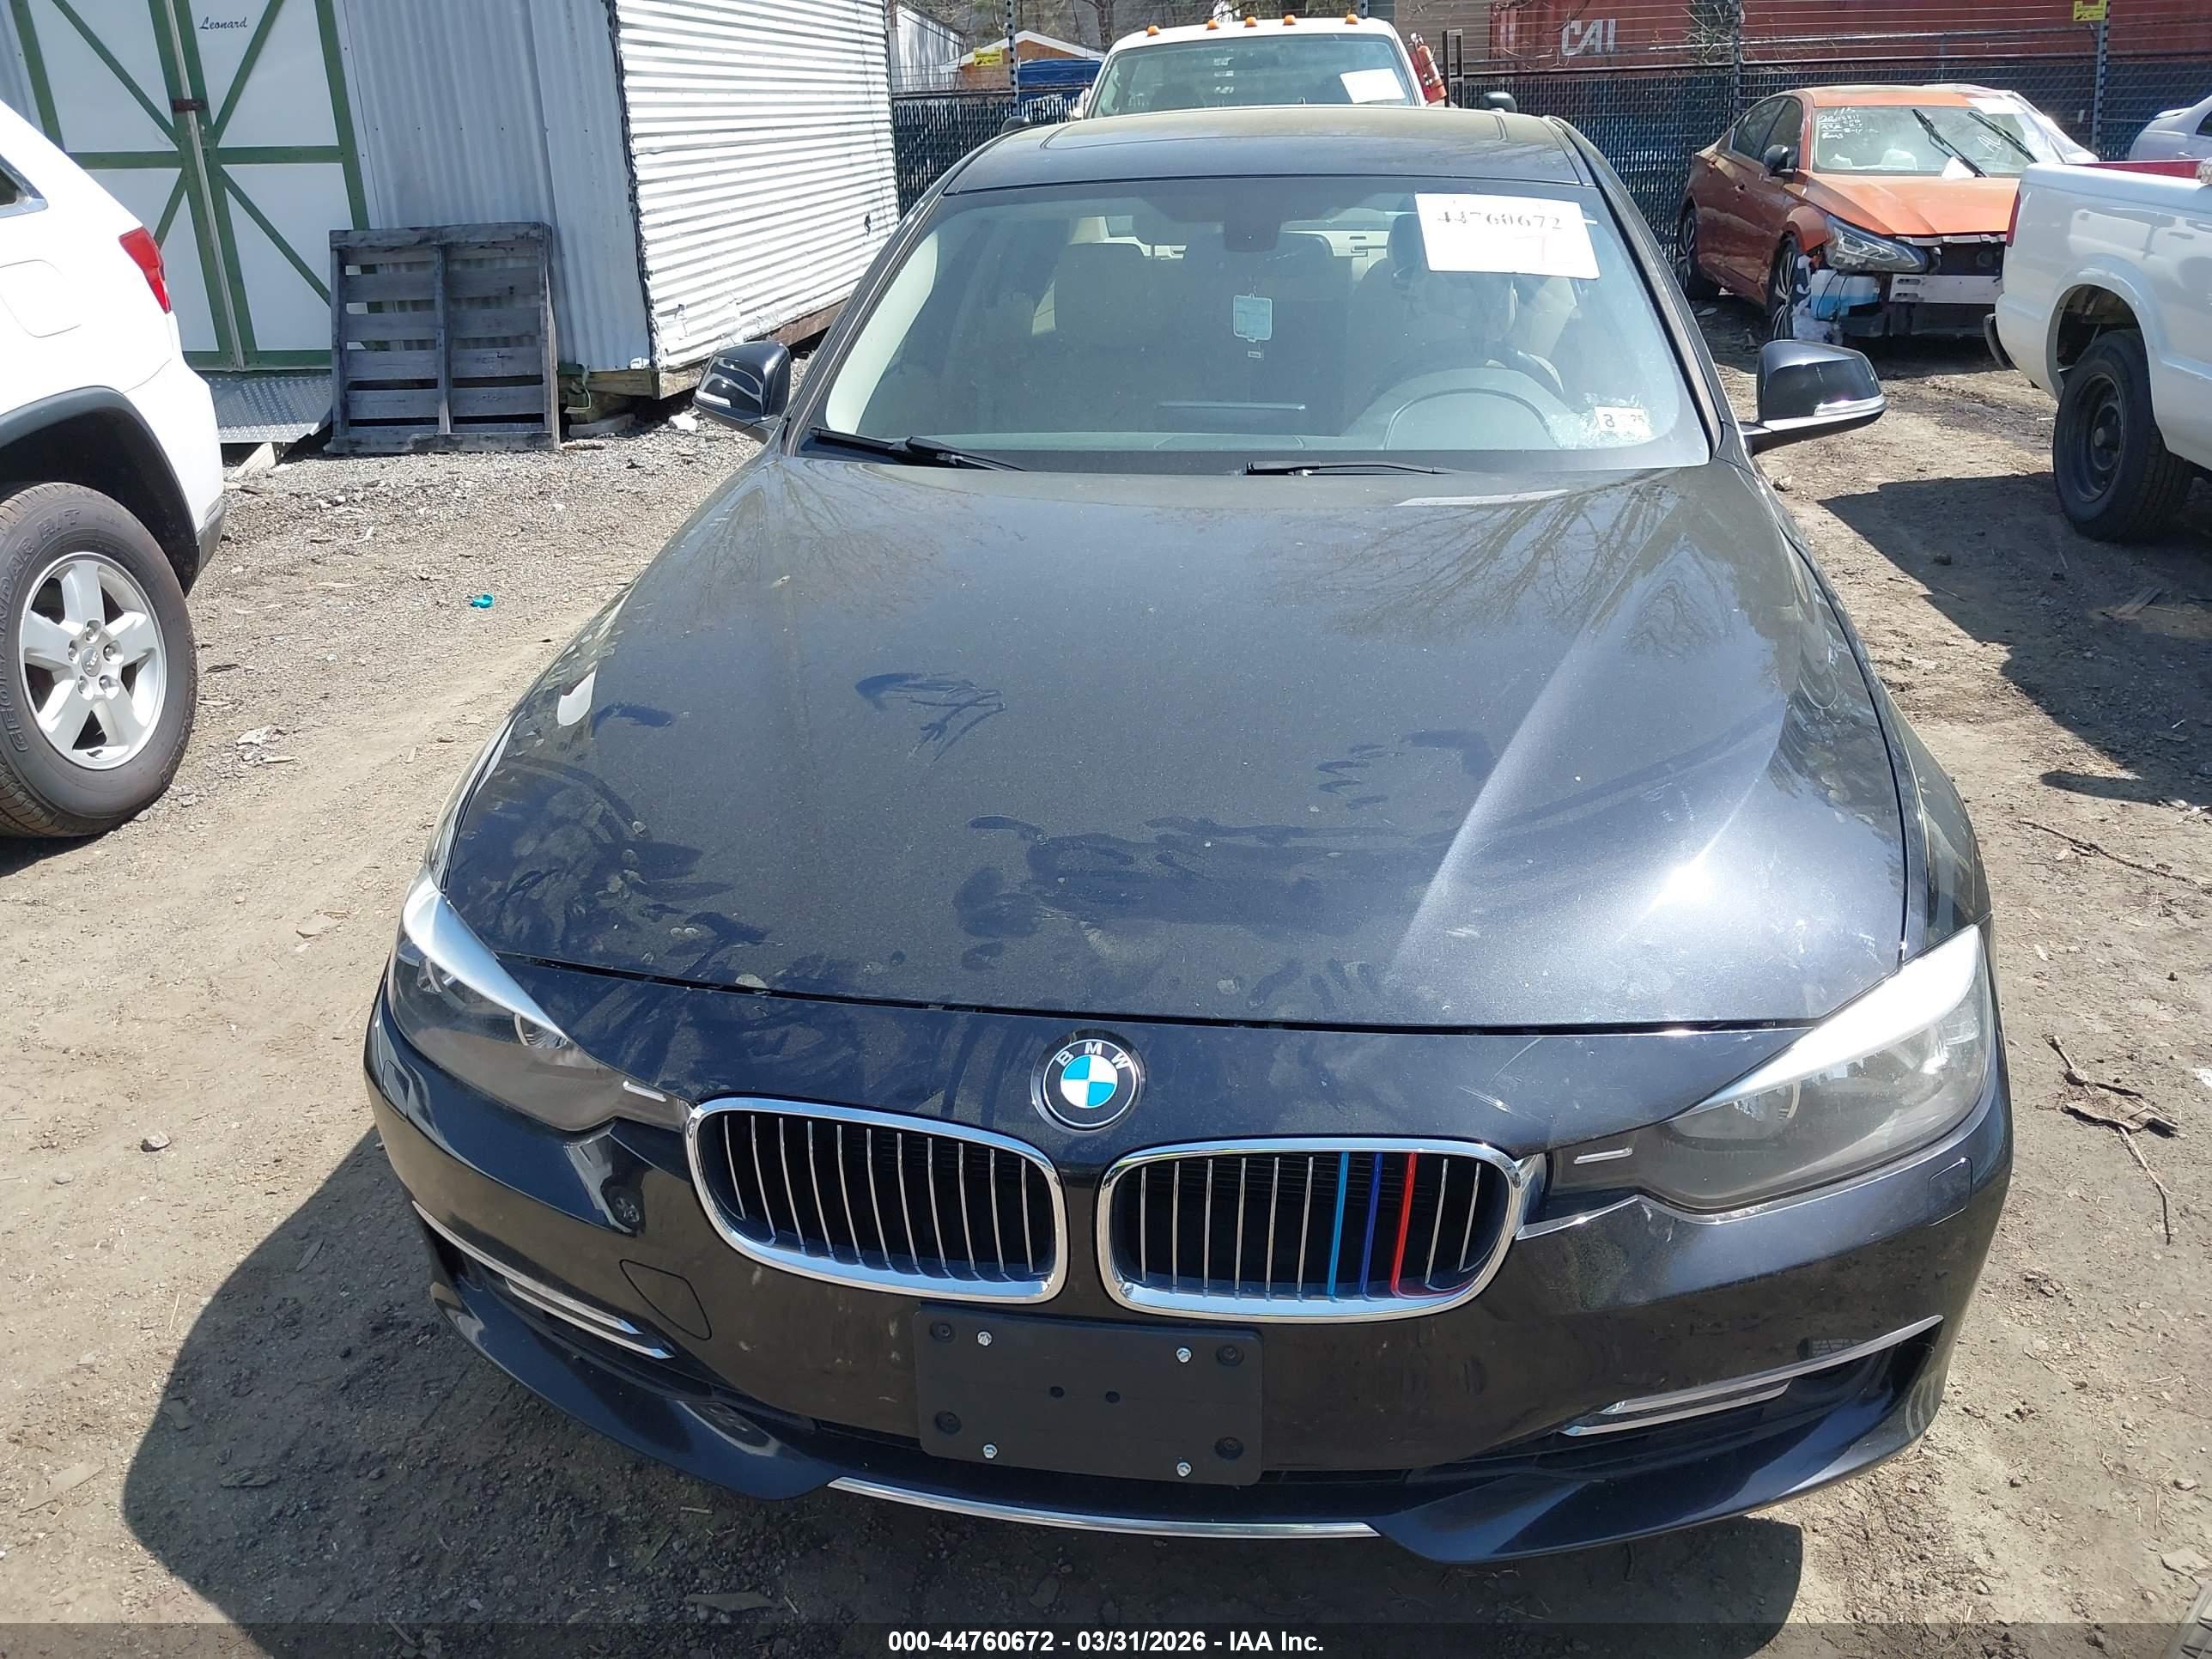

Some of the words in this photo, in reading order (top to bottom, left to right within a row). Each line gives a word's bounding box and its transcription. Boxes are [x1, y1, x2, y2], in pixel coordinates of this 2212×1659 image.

[198, 15, 248, 30] Leonard
[1561, 18, 1616, 56] CAI
[1055, 1042, 1130, 1070] BMW
